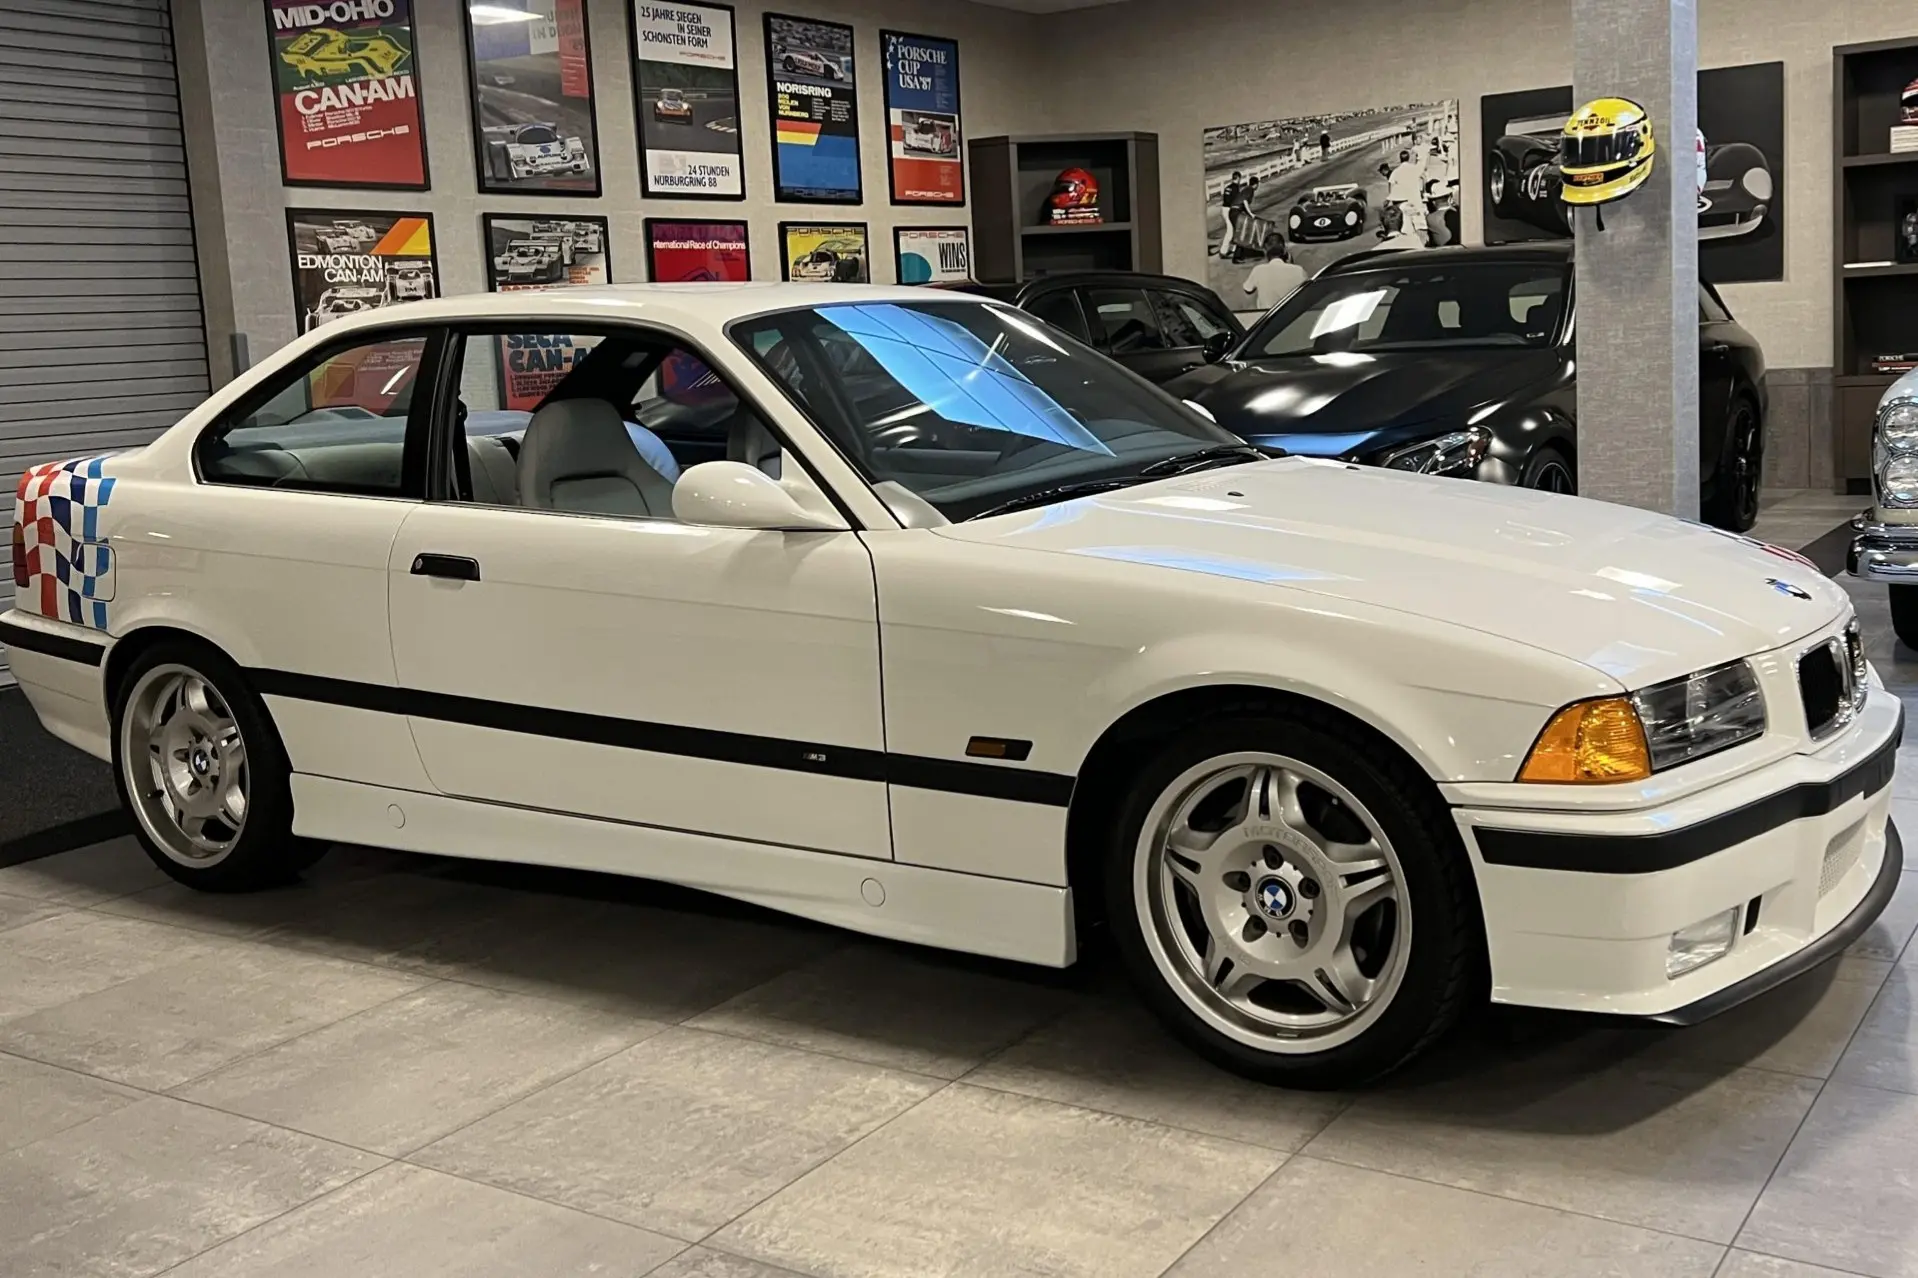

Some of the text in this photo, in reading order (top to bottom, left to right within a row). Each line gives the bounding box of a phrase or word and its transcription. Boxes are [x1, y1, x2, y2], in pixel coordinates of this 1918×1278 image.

[272, 0, 394, 29] MID-OHIO
[641, 6, 702, 24] 25 JAHRE SIEGEN
[677, 23, 711, 37] IN SEINER
[688, 36, 708, 48] FORM
[898, 45, 947, 64] PORSCHE
[898, 60, 920, 74] CUP
[899, 74, 920, 89] USA
[294, 75, 415, 115] CAN-AM
[776, 82, 832, 98] NORISRING
[306, 125, 410, 150] PORSCHE
[688, 165, 730, 177] 24 STUNDEN
[904, 190, 954, 198] PORSCHE
[787, 227, 865, 236] PORSCHE
[298, 254, 382, 269] EDMONTON
[938, 242, 967, 269] WINS
[324, 268, 384, 283] CAN-AM
